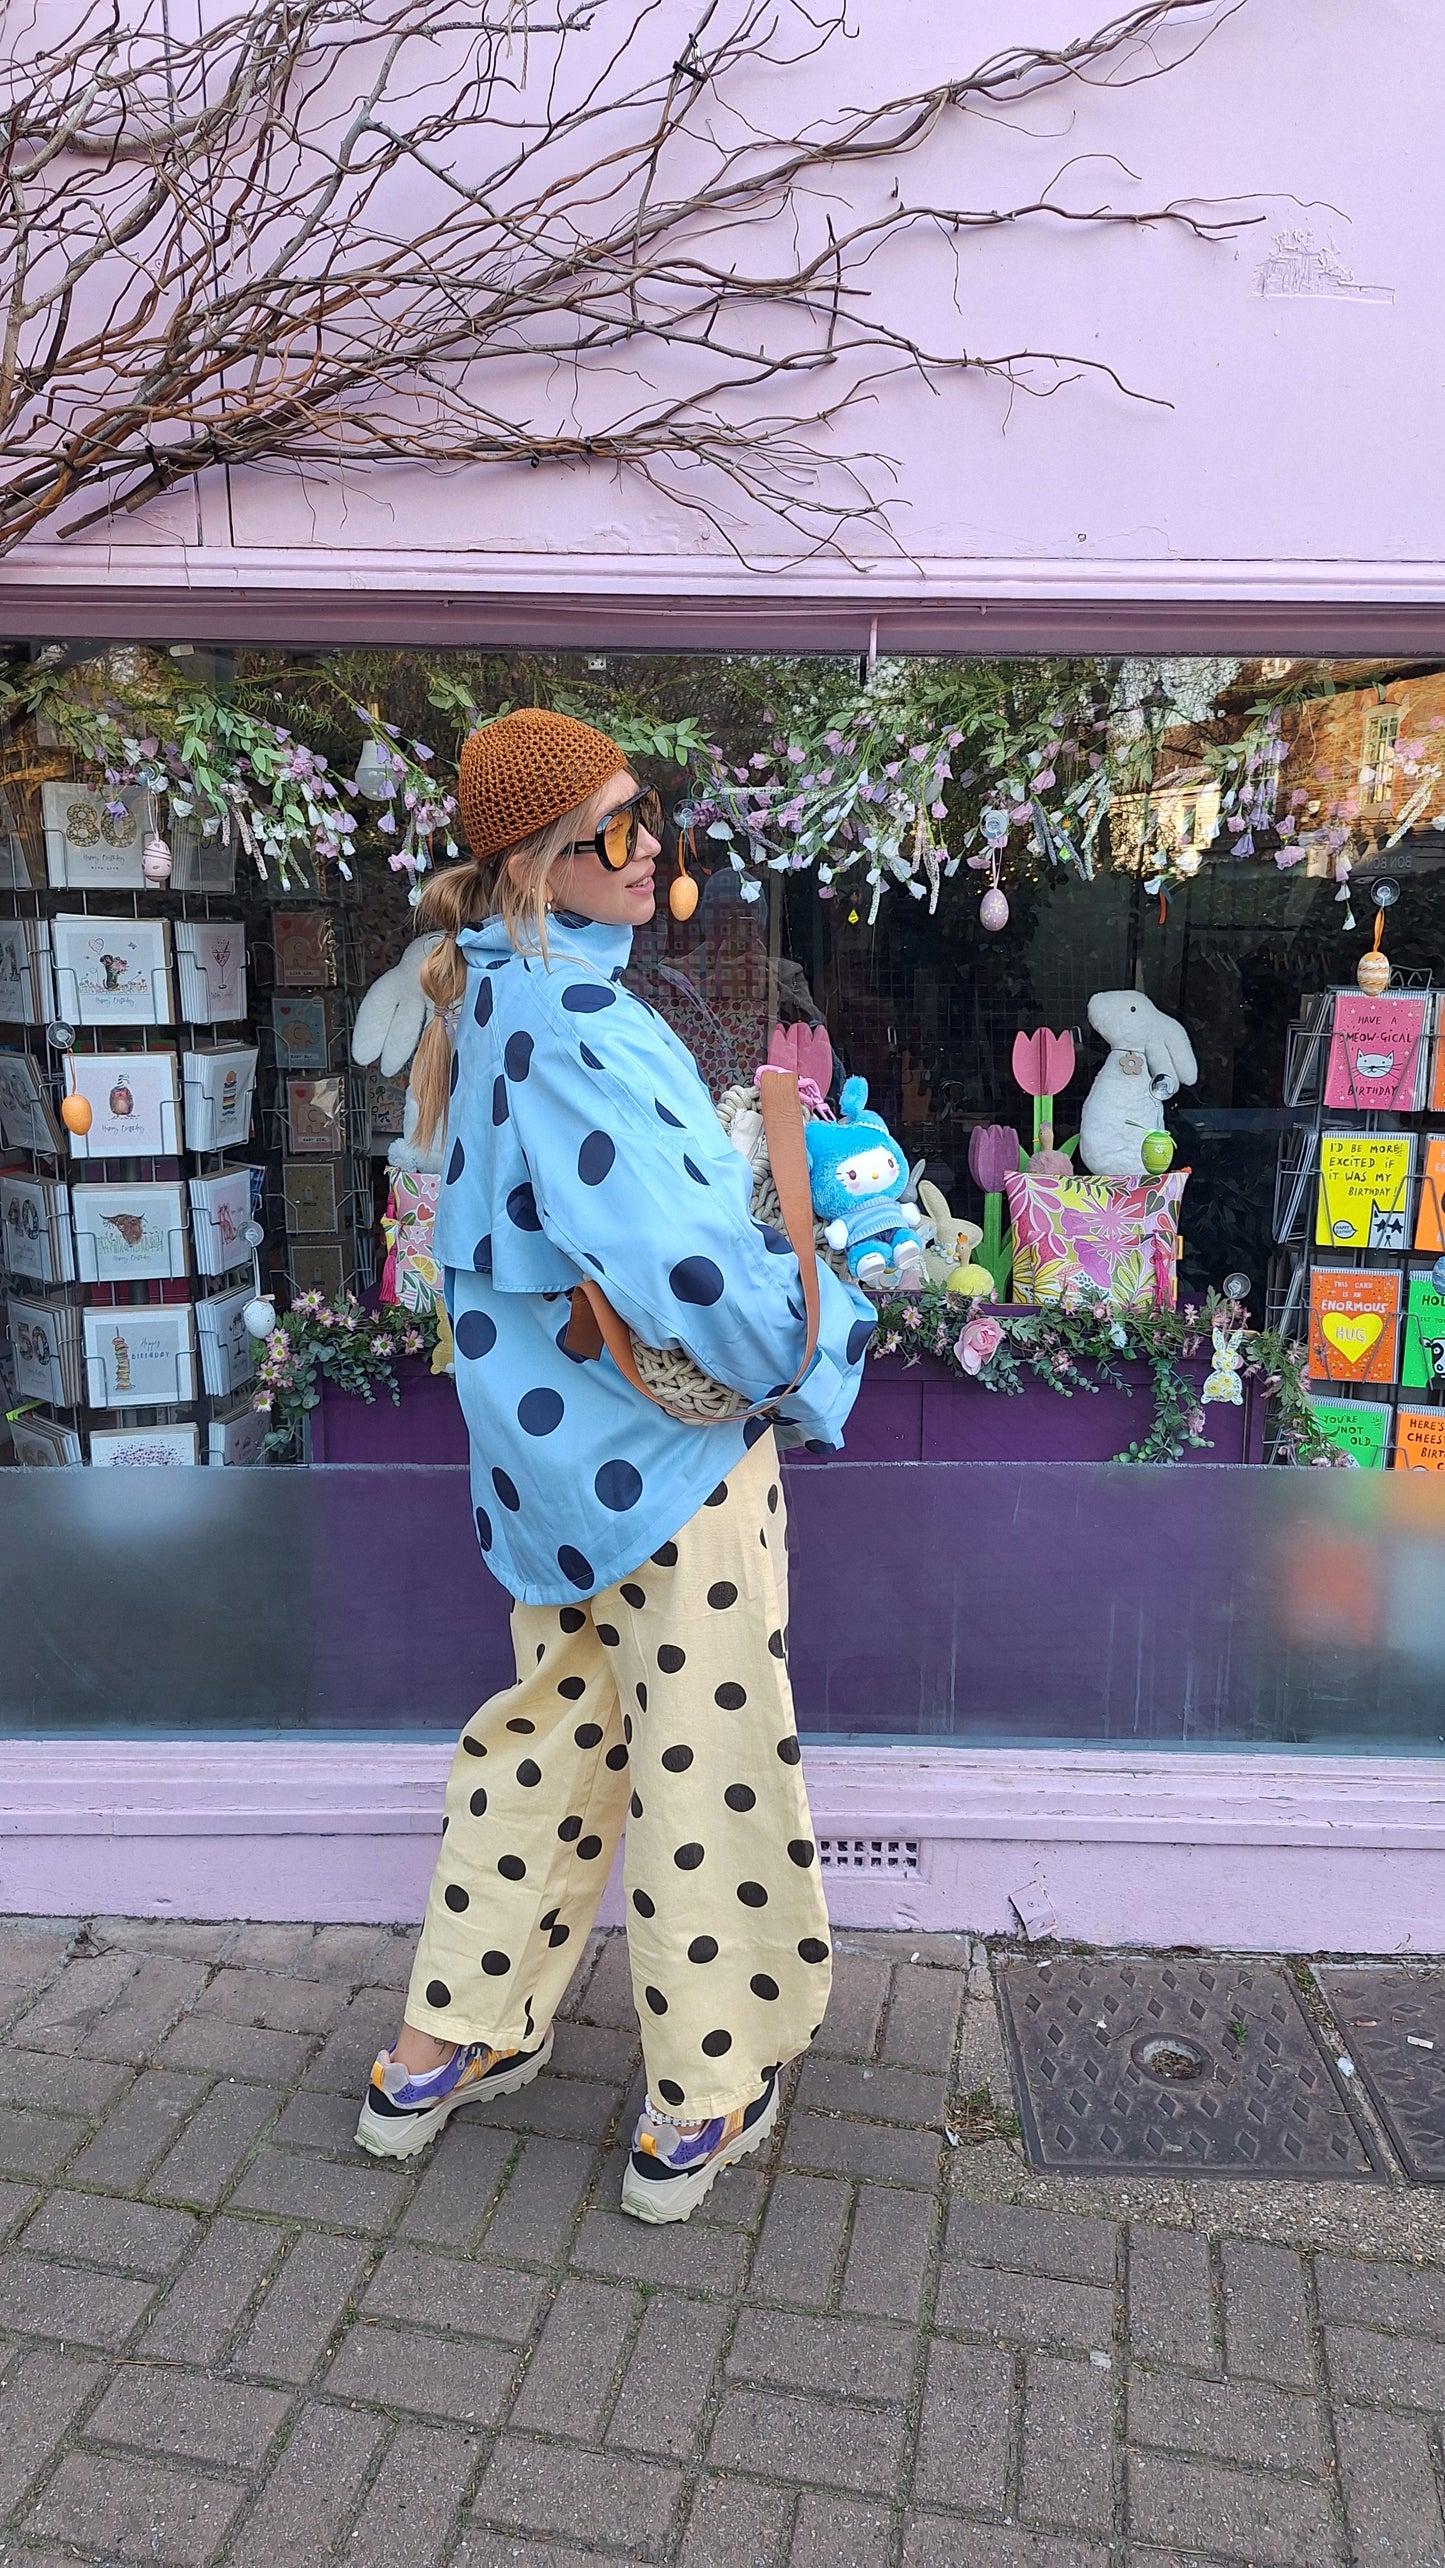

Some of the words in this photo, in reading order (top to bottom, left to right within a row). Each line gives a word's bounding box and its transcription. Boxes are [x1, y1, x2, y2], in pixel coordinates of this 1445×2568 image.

[66, 802, 137, 848] 80
[1357, 1016, 1382, 1025] HAVE
[1390, 1016, 1398, 1025] A
[1346, 1032, 1413, 1043] MEOW-GICAL
[1347, 1085, 1399, 1096] BIRTHDAY
[1330, 1142, 1343, 1153] I'D
[1351, 1143, 1363, 1153] BE
[1345, 1171, 1367, 1182] WAS
[1375, 1173, 1392, 1182] MY
[1334, 1280, 1348, 1288] THIS
[1321, 1299, 1389, 1314] ENORMOUS
[1336, 1326, 1366, 1344] HUG
[17, 1320, 50, 1366] 50
[1323, 1414, 1358, 1424] YOU'RE
[1340, 1426, 1365, 1435] NOT
[1409, 1418, 1445, 1432] HERE'S
